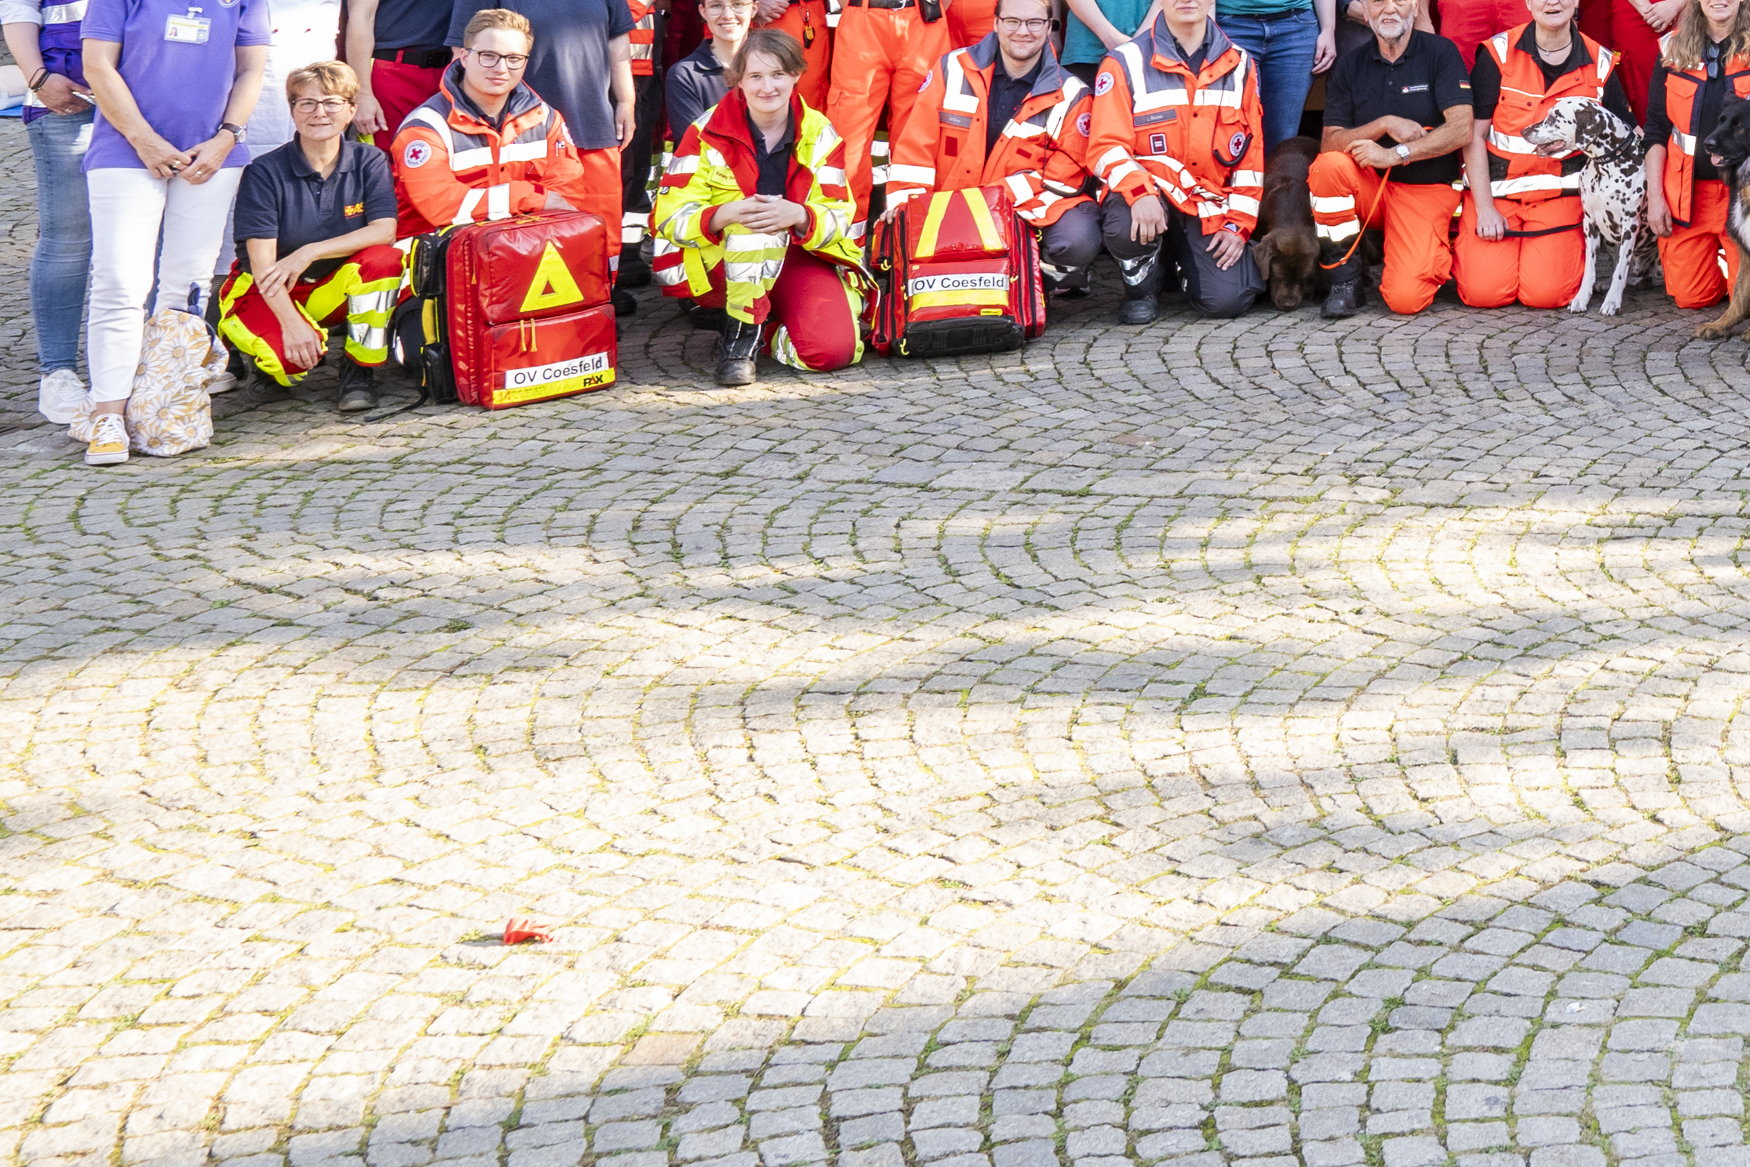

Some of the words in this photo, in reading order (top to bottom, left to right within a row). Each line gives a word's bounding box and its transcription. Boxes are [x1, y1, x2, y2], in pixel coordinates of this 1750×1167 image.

[354, 202, 364, 214] AS
[914, 278, 937, 291] OV
[940, 276, 1005, 288] Coesfeld
[514, 370, 538, 385] OV
[542, 356, 603, 381] Coesfeld
[583, 374, 604, 387] PAX
